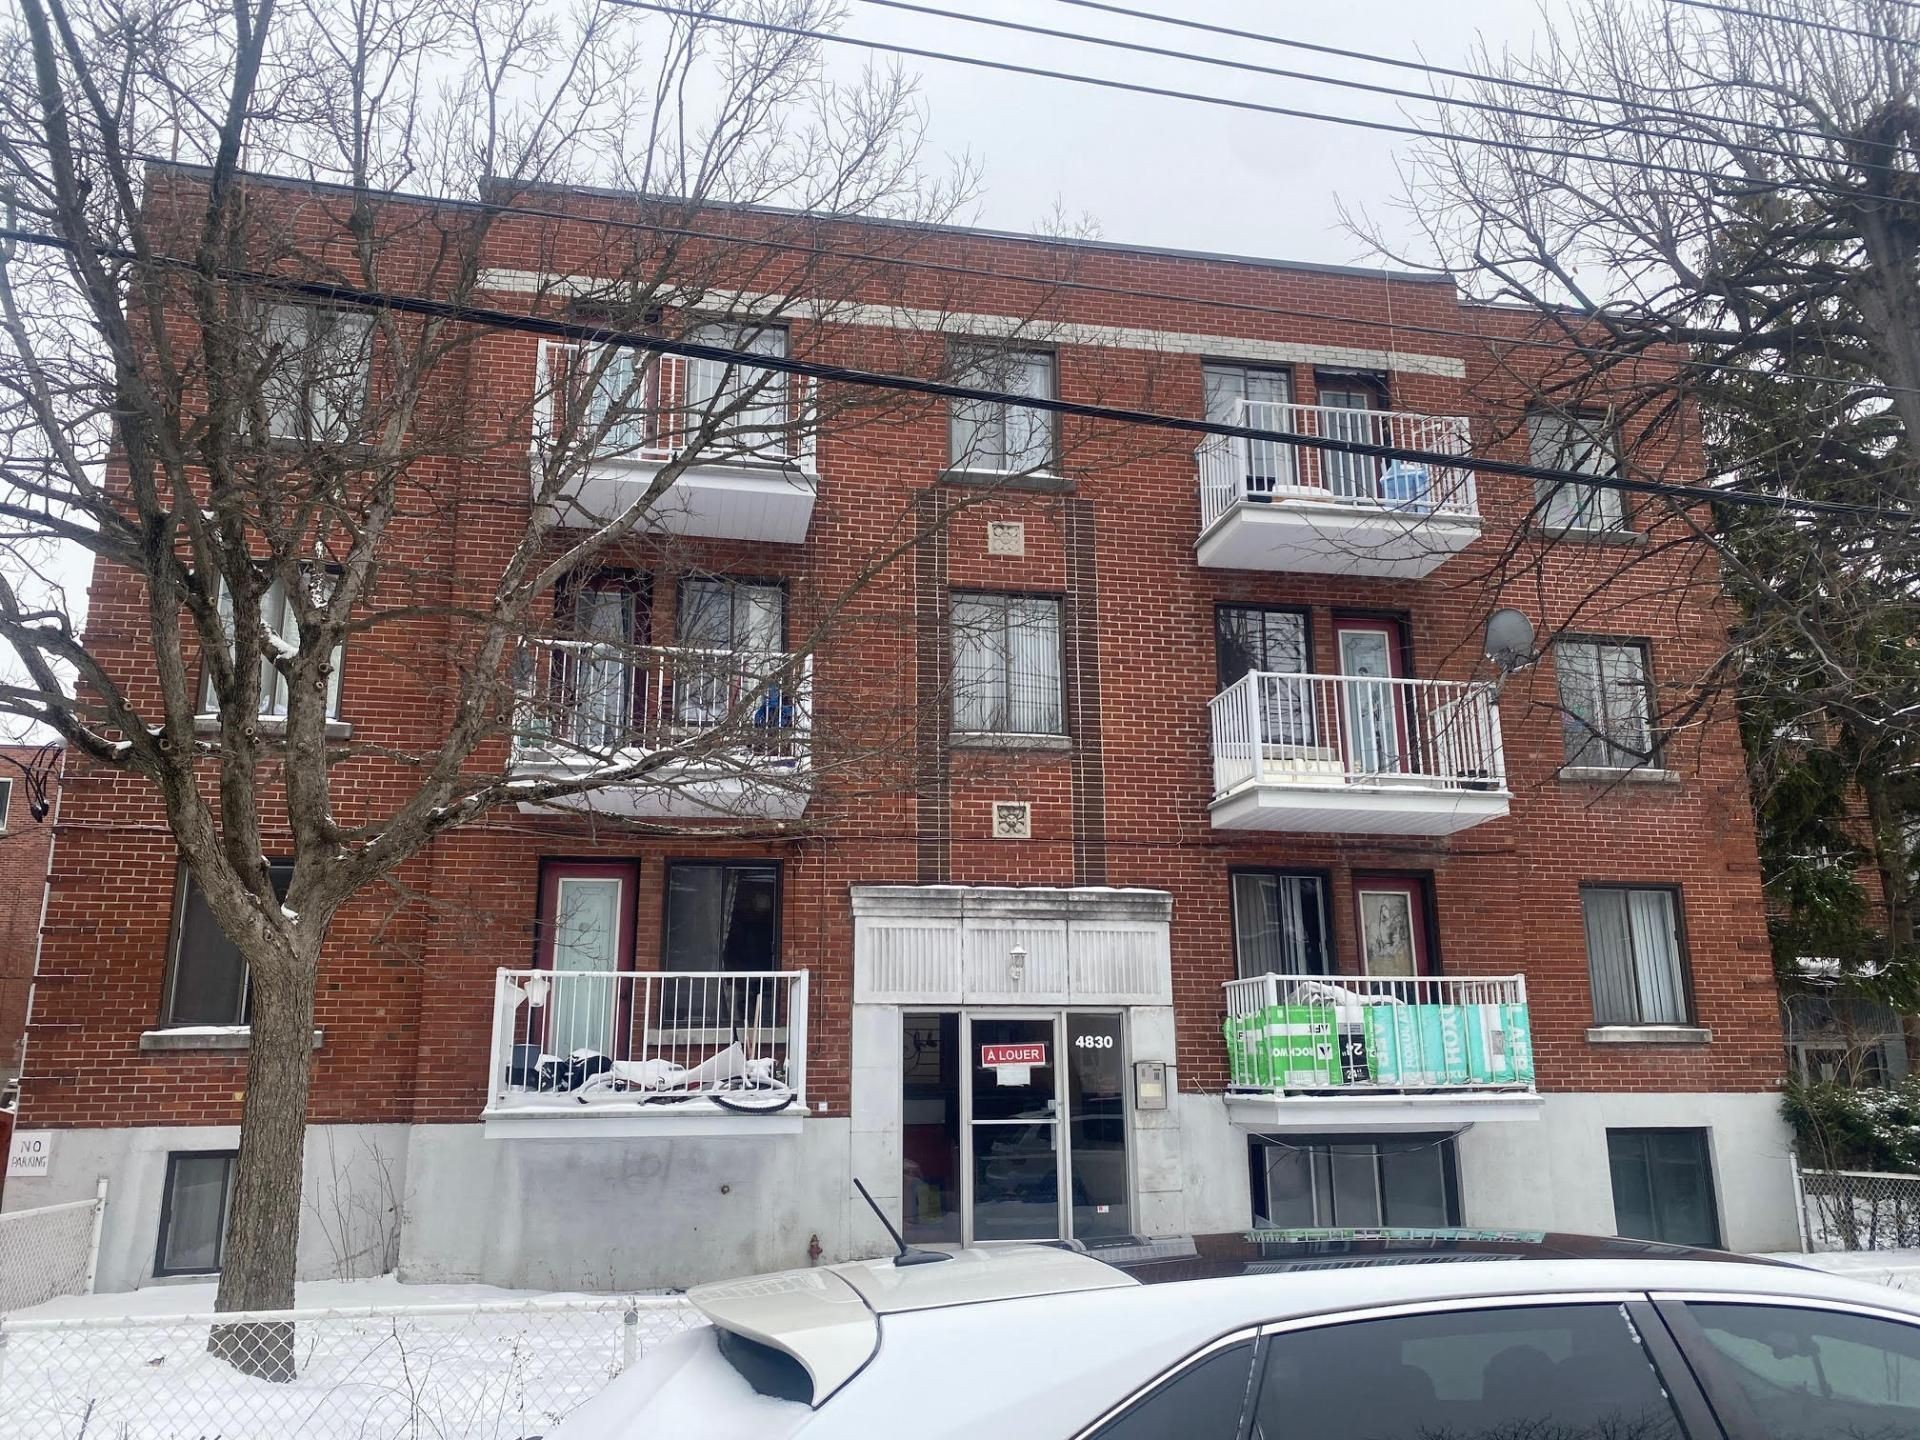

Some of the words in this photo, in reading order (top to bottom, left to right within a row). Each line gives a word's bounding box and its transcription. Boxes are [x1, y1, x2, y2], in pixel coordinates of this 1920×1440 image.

[1075, 1035, 1113, 1048] 4830
[999, 1049, 1040, 1061] LOUER
[20, 1140, 42, 1153] NO
